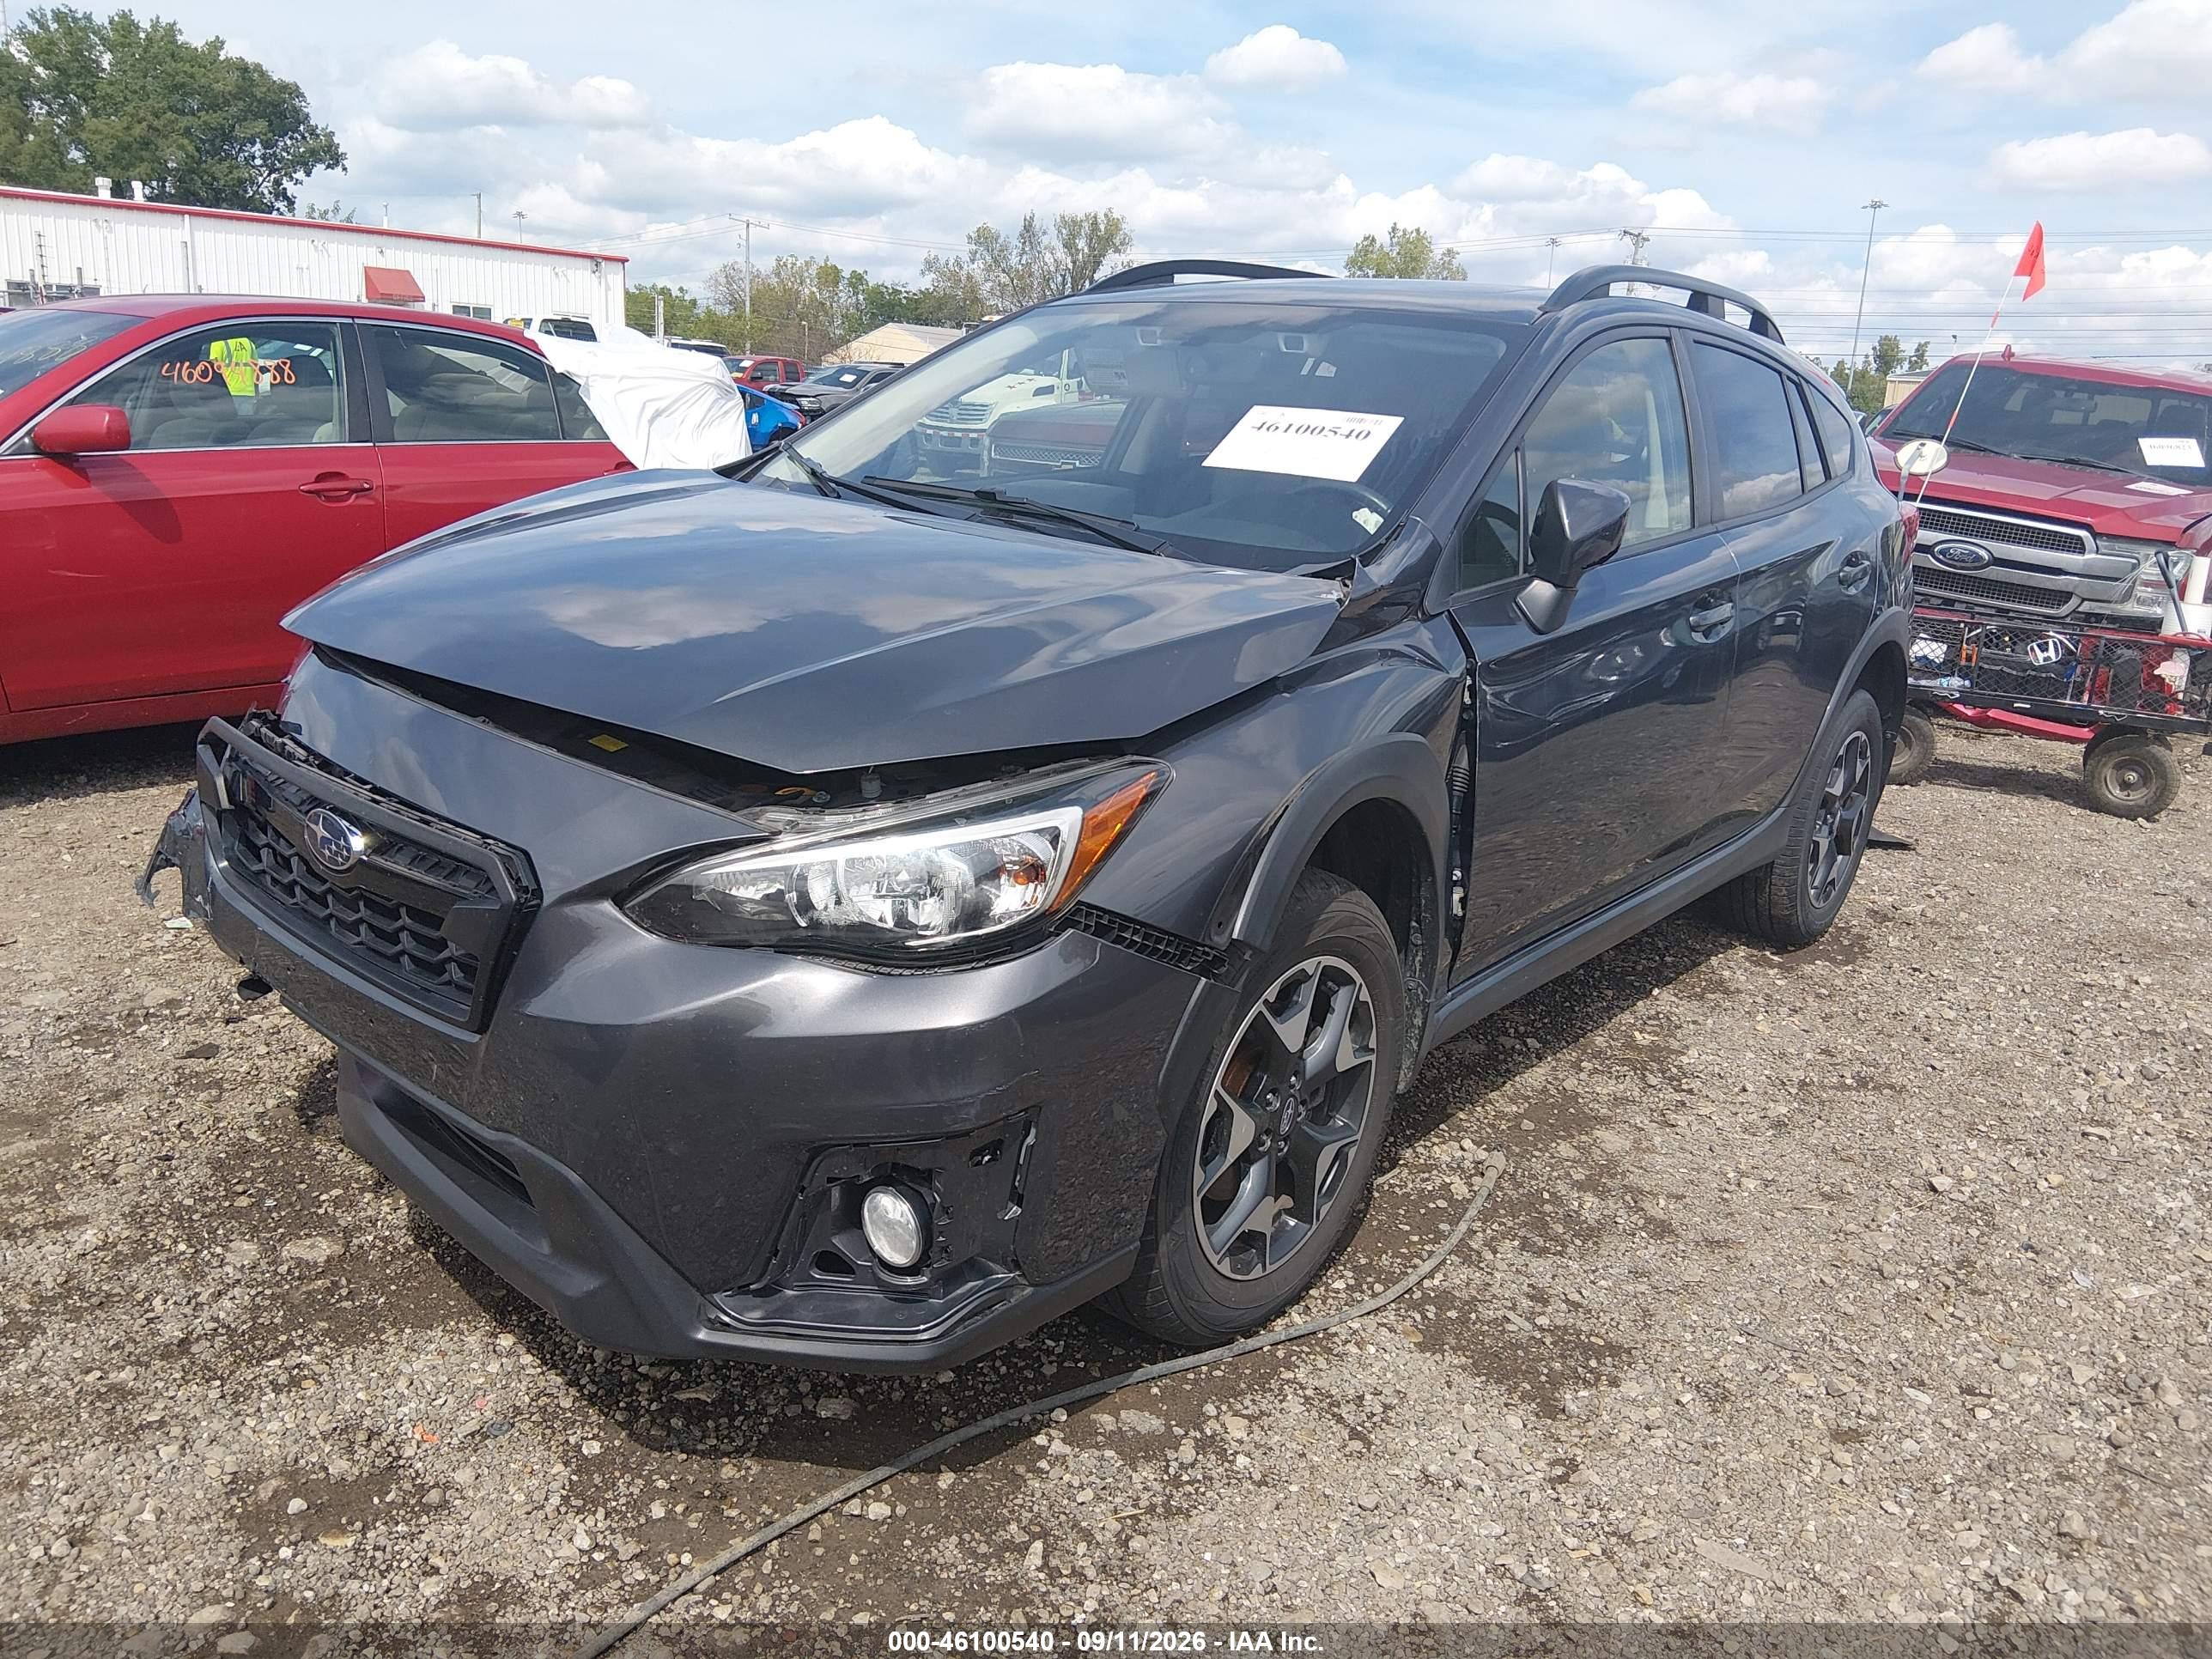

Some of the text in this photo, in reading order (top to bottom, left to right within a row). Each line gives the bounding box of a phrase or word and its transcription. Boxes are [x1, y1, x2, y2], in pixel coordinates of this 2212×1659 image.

[161, 358, 296, 386] 46094888
[1250, 421, 1371, 441] 46100540
[1945, 547, 1977, 562] Ford
